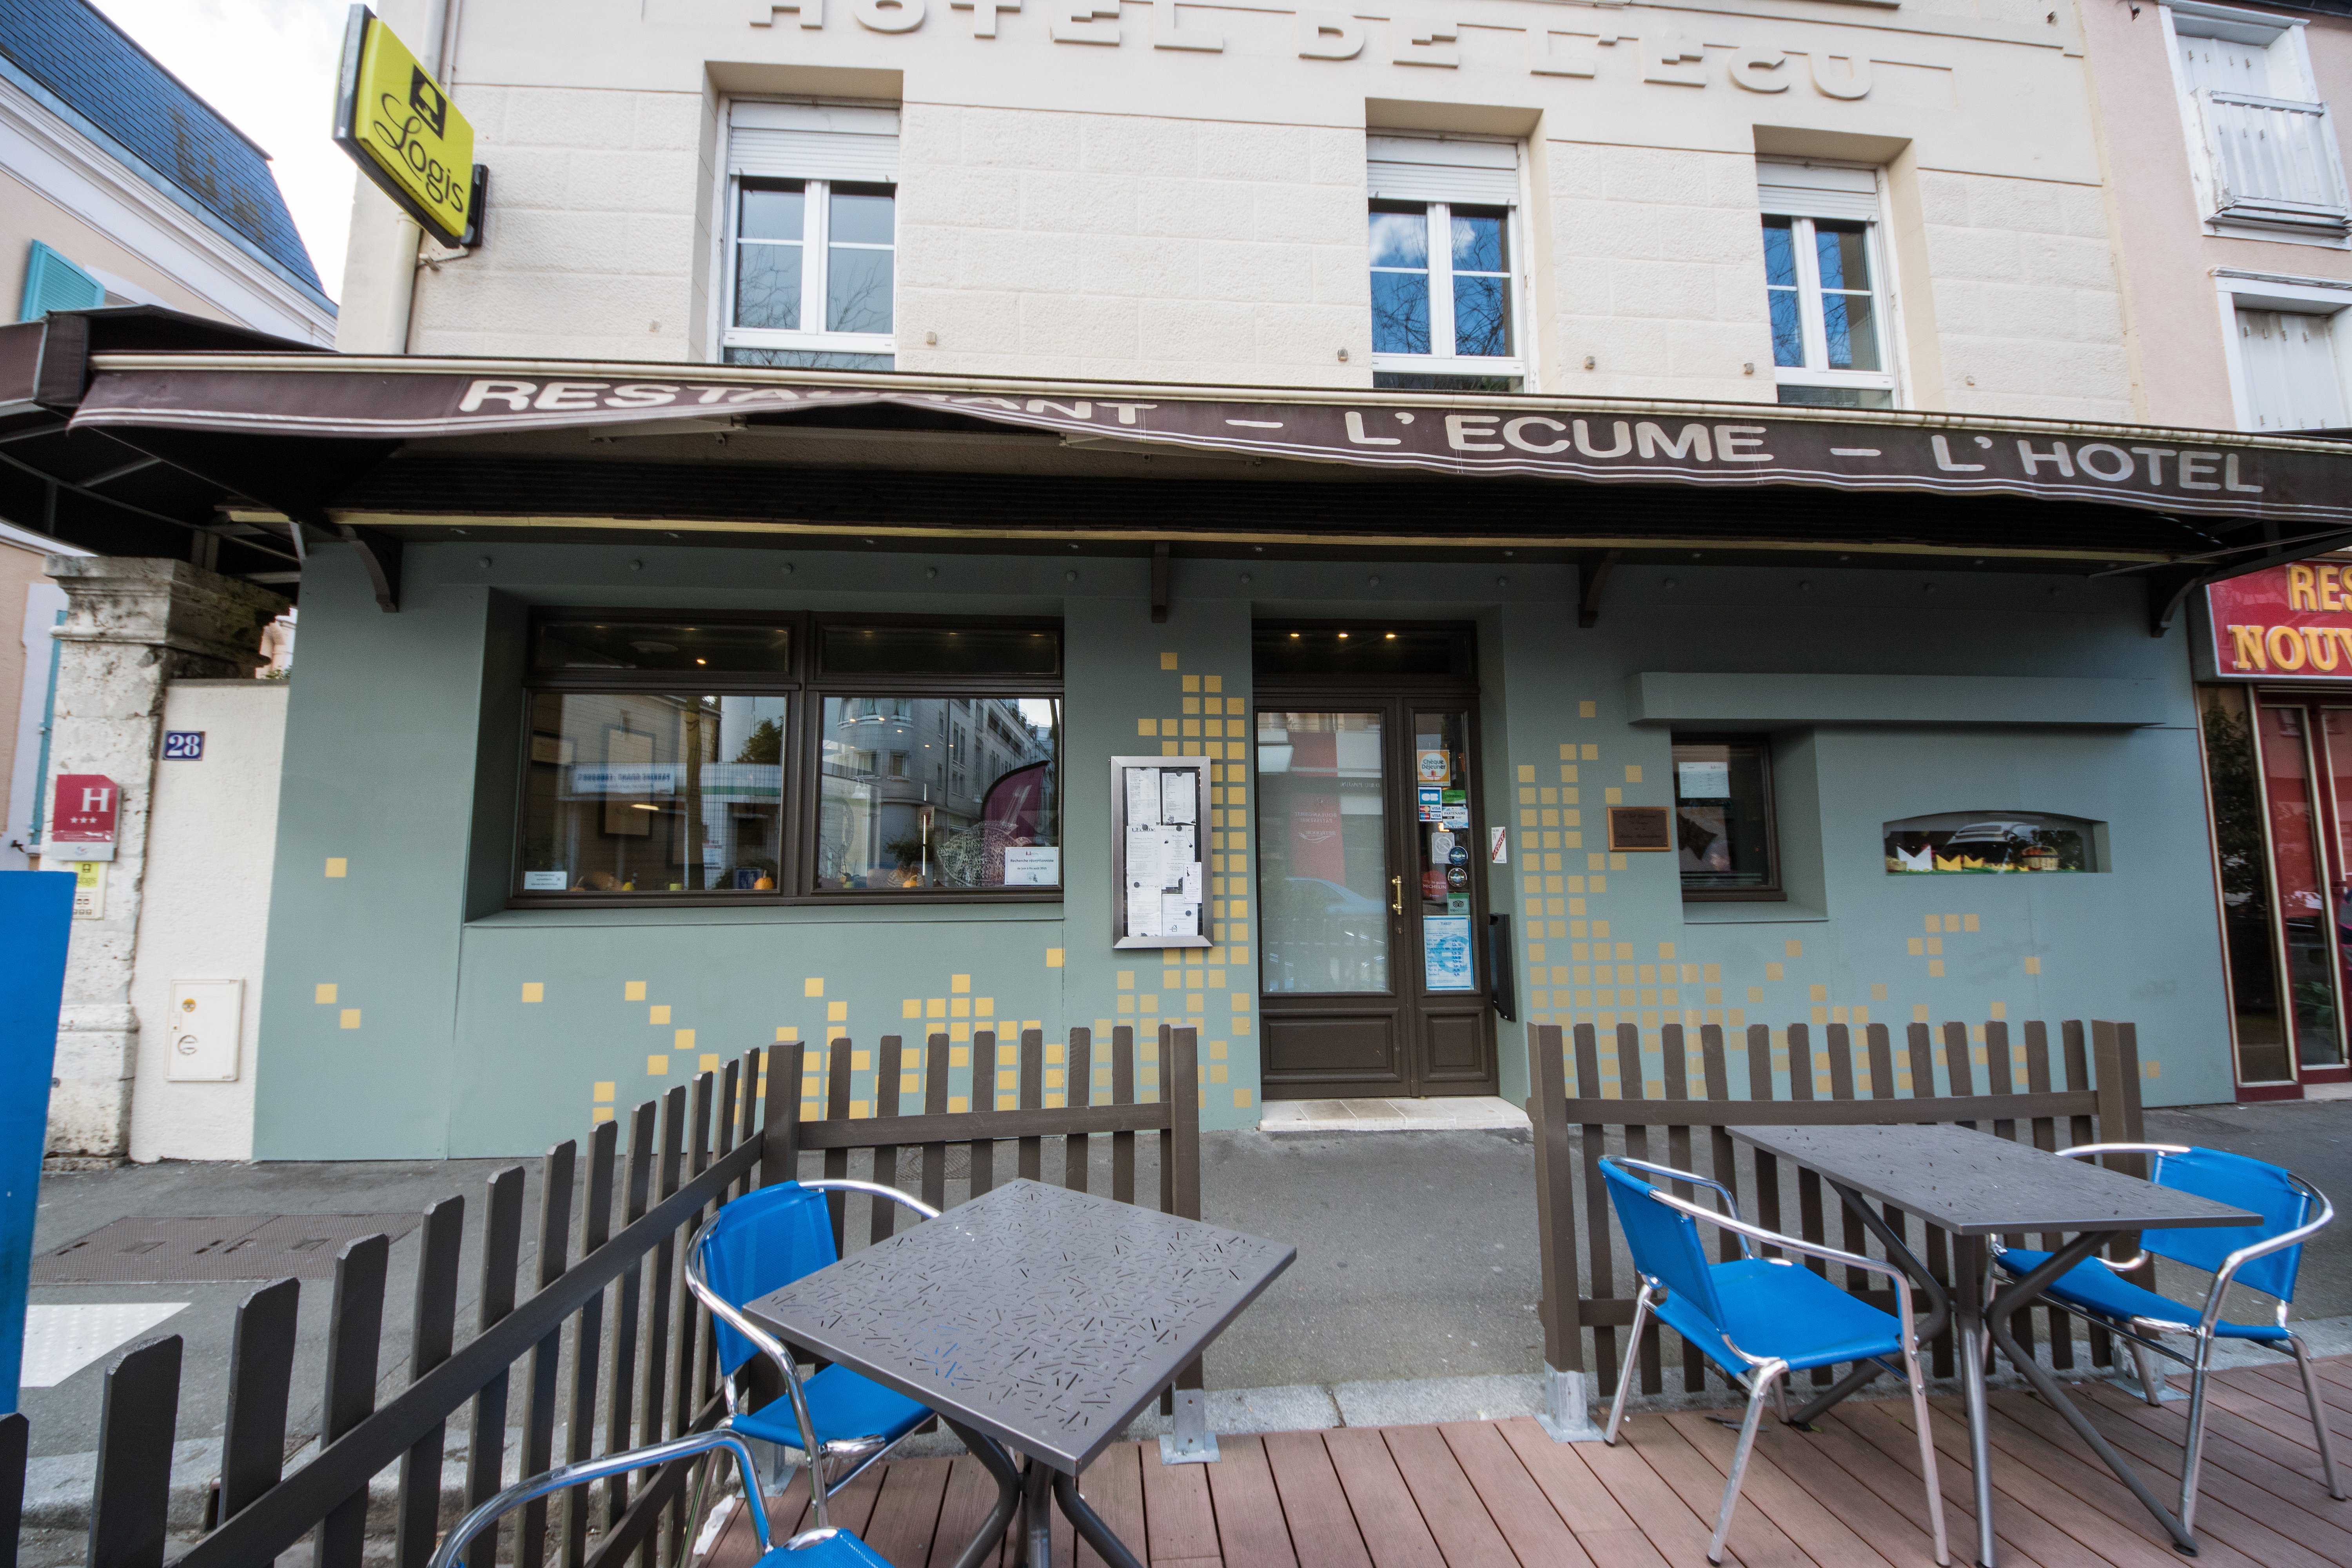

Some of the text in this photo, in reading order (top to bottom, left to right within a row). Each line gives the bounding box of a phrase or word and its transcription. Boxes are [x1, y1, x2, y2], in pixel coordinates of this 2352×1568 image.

[1298, 13, 1460, 69] DE
[373, 93, 464, 213] Logis
[459, 378, 1157, 425] RESTAANT
[166, 734, 200, 757] 28
[79, 788, 112, 812] H
[1494, 831, 1504, 858] LICENCE
